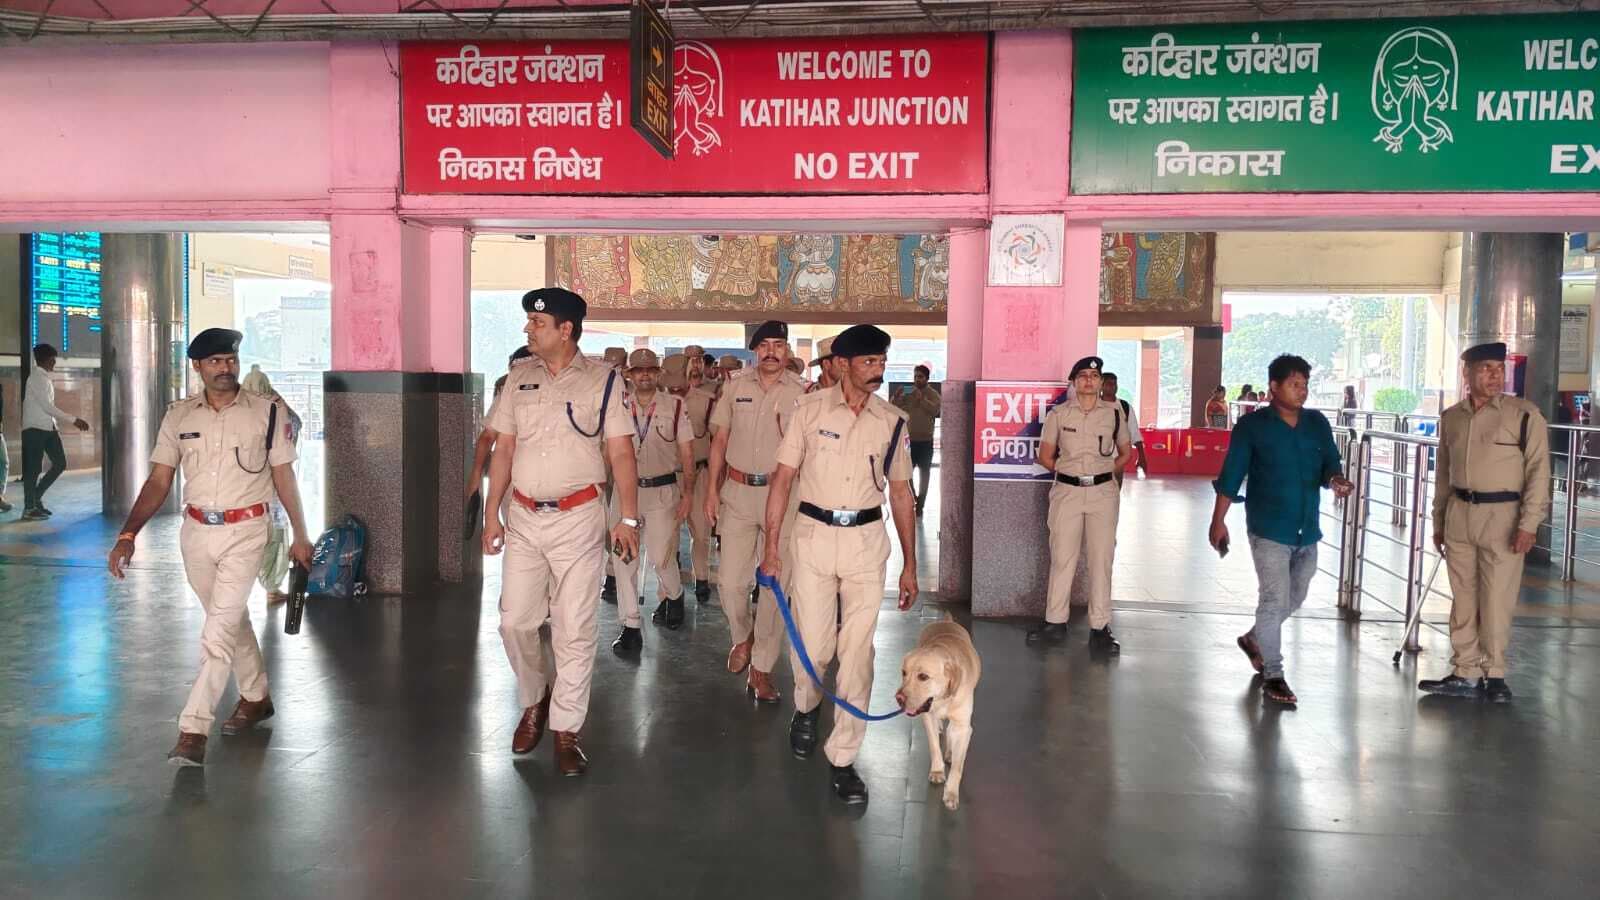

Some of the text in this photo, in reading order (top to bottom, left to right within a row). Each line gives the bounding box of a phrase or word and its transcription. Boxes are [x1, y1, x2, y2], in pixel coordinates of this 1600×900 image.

[436, 45, 605, 87] कटिहार जंक्शन
[778, 49, 931, 81] WELCOME TO
[1122, 32, 1322, 79] कटिहार जंक्शन
[1523, 38, 1599, 70] WELC
[426, 103, 454, 128] पर
[456, 103, 523, 128] आपका
[526, 102, 593, 128] स्वागत
[647, 98, 668, 137] EXIT
[741, 95, 969, 127] KATIHAR JUNCTION
[1108, 98, 1141, 125] पर
[1143, 97, 1222, 125] आपका
[1226, 95, 1305, 124] स्वागत
[1477, 90, 1595, 121] KATIHAR
[438, 146, 604, 182] निकास निषेध
[795, 152, 920, 181] NO EXIT
[1154, 140, 1286, 177] निकास
[1550, 144, 1600, 174] EX
[986, 392, 1052, 424] EXIT
[981, 427, 1041, 460] निका
